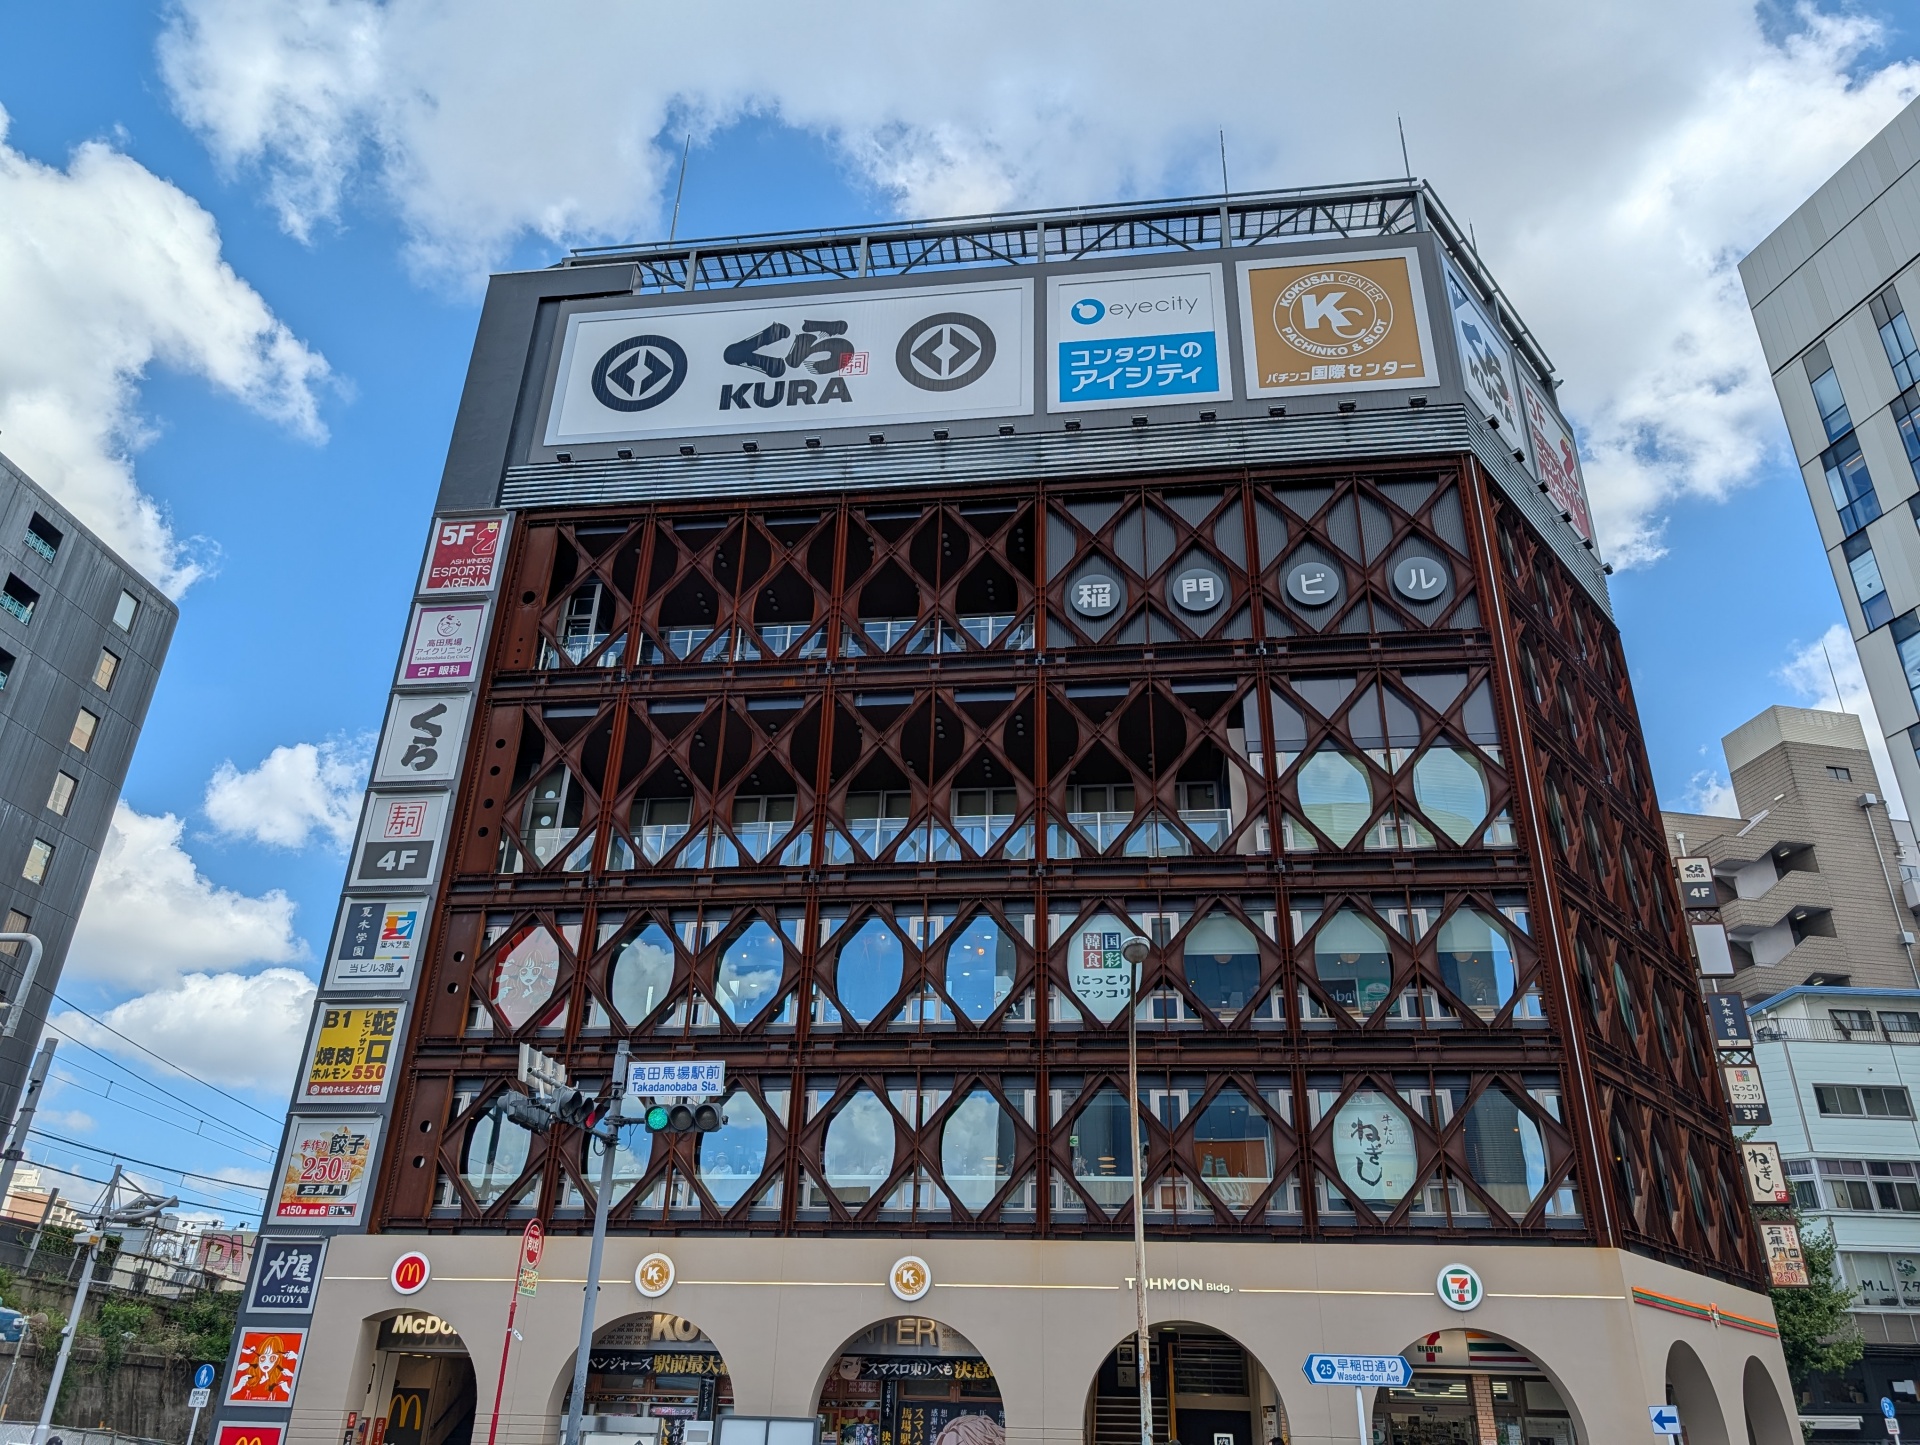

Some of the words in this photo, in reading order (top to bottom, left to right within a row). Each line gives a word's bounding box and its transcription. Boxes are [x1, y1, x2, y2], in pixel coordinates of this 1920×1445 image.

[1279, 273, 1335, 308] KOKUSAI
[1338, 273, 1384, 303] CENTER
[1109, 295, 1199, 320] eyecity
[1281, 325, 1349, 356] PACHINKO
[1352, 343, 1364, 352] &
[1363, 318, 1388, 346] SLOT
[723, 319, 855, 378] くら
[1070, 341, 1203, 367] コンタクトの
[1072, 363, 1204, 393] アイシティ
[1265, 360, 1417, 384] パチンコ国際センター
[718, 376, 853, 411] KURA
[1467, 353, 1518, 436] KURA
[1525, 387, 1547, 431] 5F
[441, 524, 475, 546] 5F
[432, 564, 491, 578] ESPORTS
[450, 558, 465, 566] ASH
[441, 577, 488, 588] ARENA
[415, 646, 472, 656] アイクリニック
[426, 638, 463, 647] 高田馬場
[417, 666, 435, 677] 2F
[438, 664, 461, 676] 眼科
[401, 702, 448, 772] くら
[376, 849, 419, 872] 4F
[1690, 887, 1710, 898] 4F
[348, 962, 396, 974] 当ビル3階
[1076, 974, 1130, 986] にっこり
[1076, 988, 1131, 999] マッコリ
[323, 1010, 352, 1029] B1
[356, 1010, 374, 1064] レモンサワー
[364, 1010, 398, 1065] 蛇口
[315, 1046, 355, 1067] 焼肉
[311, 1067, 351, 1080] ホルモン
[351, 1064, 387, 1080] 550
[632, 1065, 721, 1081] 高田馬場駅前
[632, 1081, 698, 1092] Takadanobaba
[701, 1081, 719, 1092] Sta.
[1731, 1083, 1759, 1092] にっこり
[1733, 1092, 1761, 1100] マッコリ
[1743, 1109, 1759, 1120] 3F
[1381, 1113, 1395, 1145] 牛たん
[300, 1139, 330, 1151] 手作り
[329, 1134, 366, 1155] 餃子
[1350, 1116, 1384, 1187] ねぎし
[1747, 1148, 1775, 1194] ねぎし
[1776, 1191, 1787, 1200] 2F
[262, 1249, 313, 1288] 大戸屋
[1206, 1282, 1234, 1294] Bldg.
[1861, 1279, 1895, 1292] M.L.
[260, 1294, 304, 1304] OOTOYA
[391, 1314, 458, 1335] McDo
[651, 1313, 711, 1342] KO
[1320, 1363, 1332, 1375] 25
[1337, 1358, 1399, 1373] 早稲田通り
[1337, 1370, 1384, 1383] Waseda-dori
[1386, 1373, 1402, 1383] Ave.
